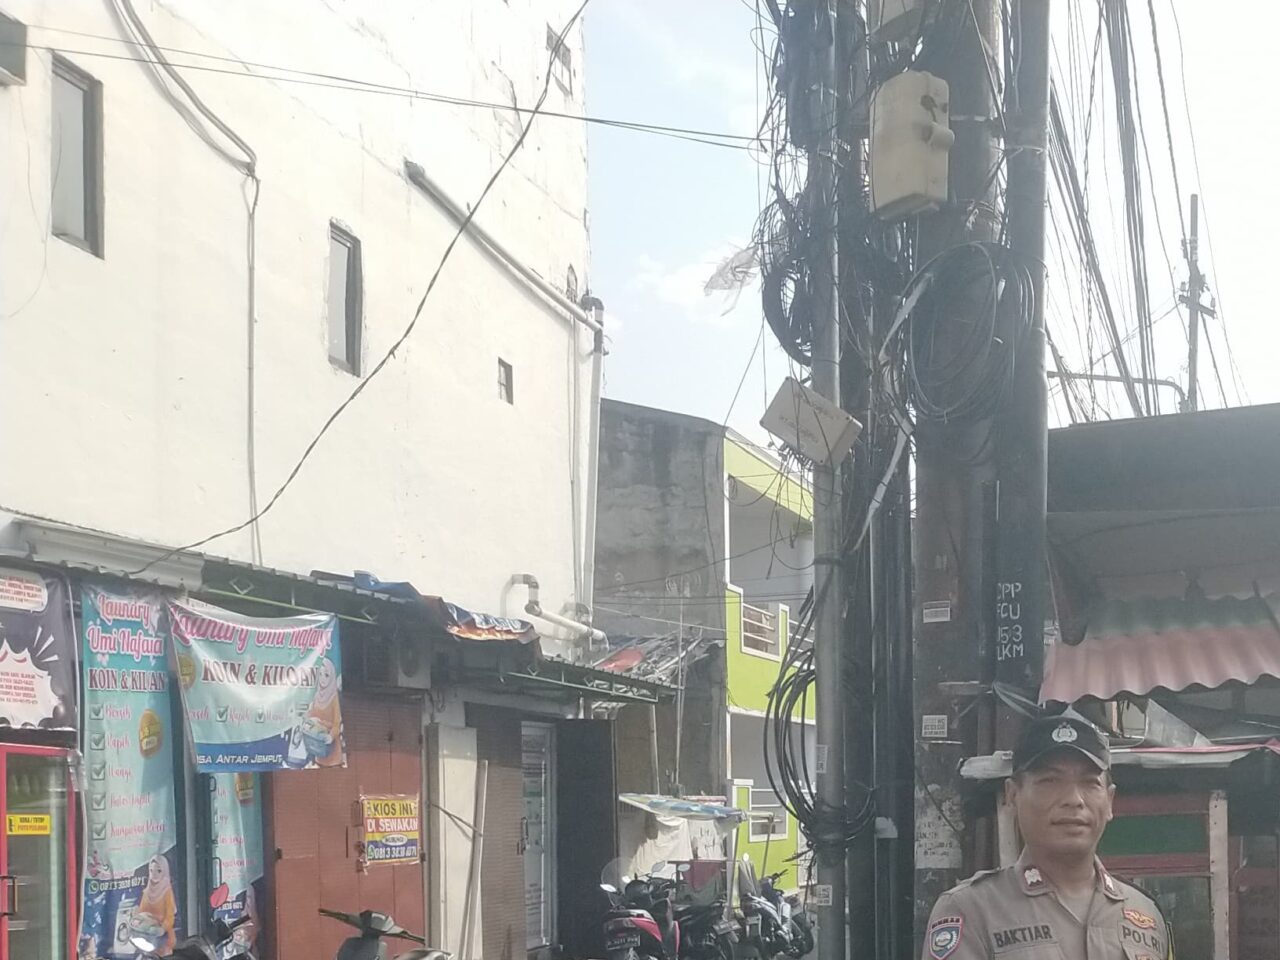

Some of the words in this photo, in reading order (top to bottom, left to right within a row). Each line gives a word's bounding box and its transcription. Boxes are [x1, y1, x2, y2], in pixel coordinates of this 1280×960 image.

[88, 668, 117, 689] KOIN
[131, 670, 167, 691] KILAN
[202, 659, 241, 683] KOIN
[373, 803, 397, 816] KIOS
[400, 803, 413, 815] INI
[367, 819, 376, 832] DI
[379, 818, 418, 831] SEWAKAN
[993, 925, 1053, 948] BAKTIAR
[1121, 925, 1162, 954] POLRI
